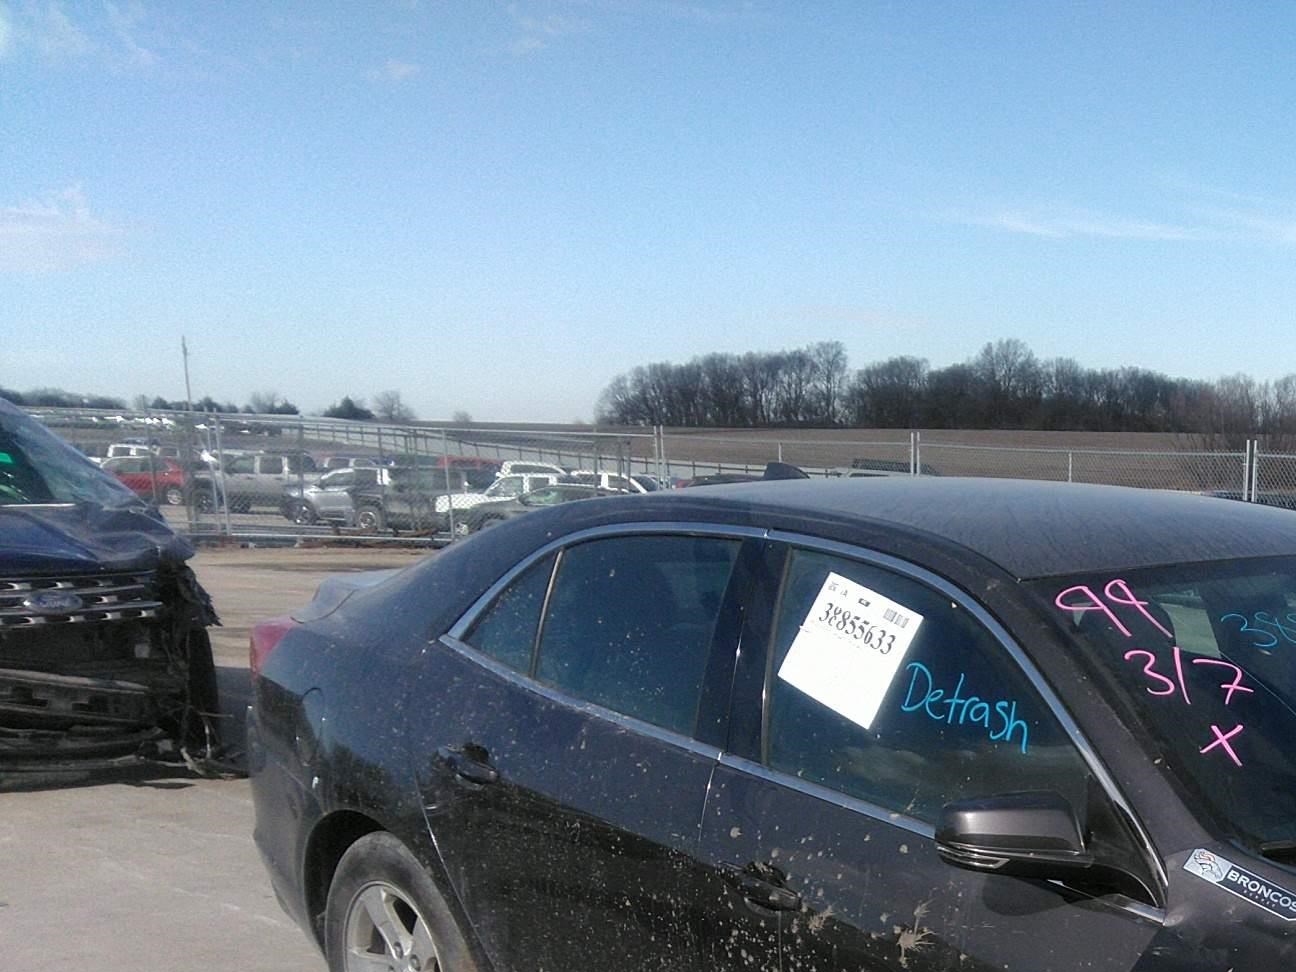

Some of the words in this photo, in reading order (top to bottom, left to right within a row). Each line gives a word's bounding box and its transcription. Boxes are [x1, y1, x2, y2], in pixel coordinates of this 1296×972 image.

[818, 602, 896, 655] 38855633
[1055, 579, 1174, 638] 99
[900, 661, 1028, 755] Detrash
